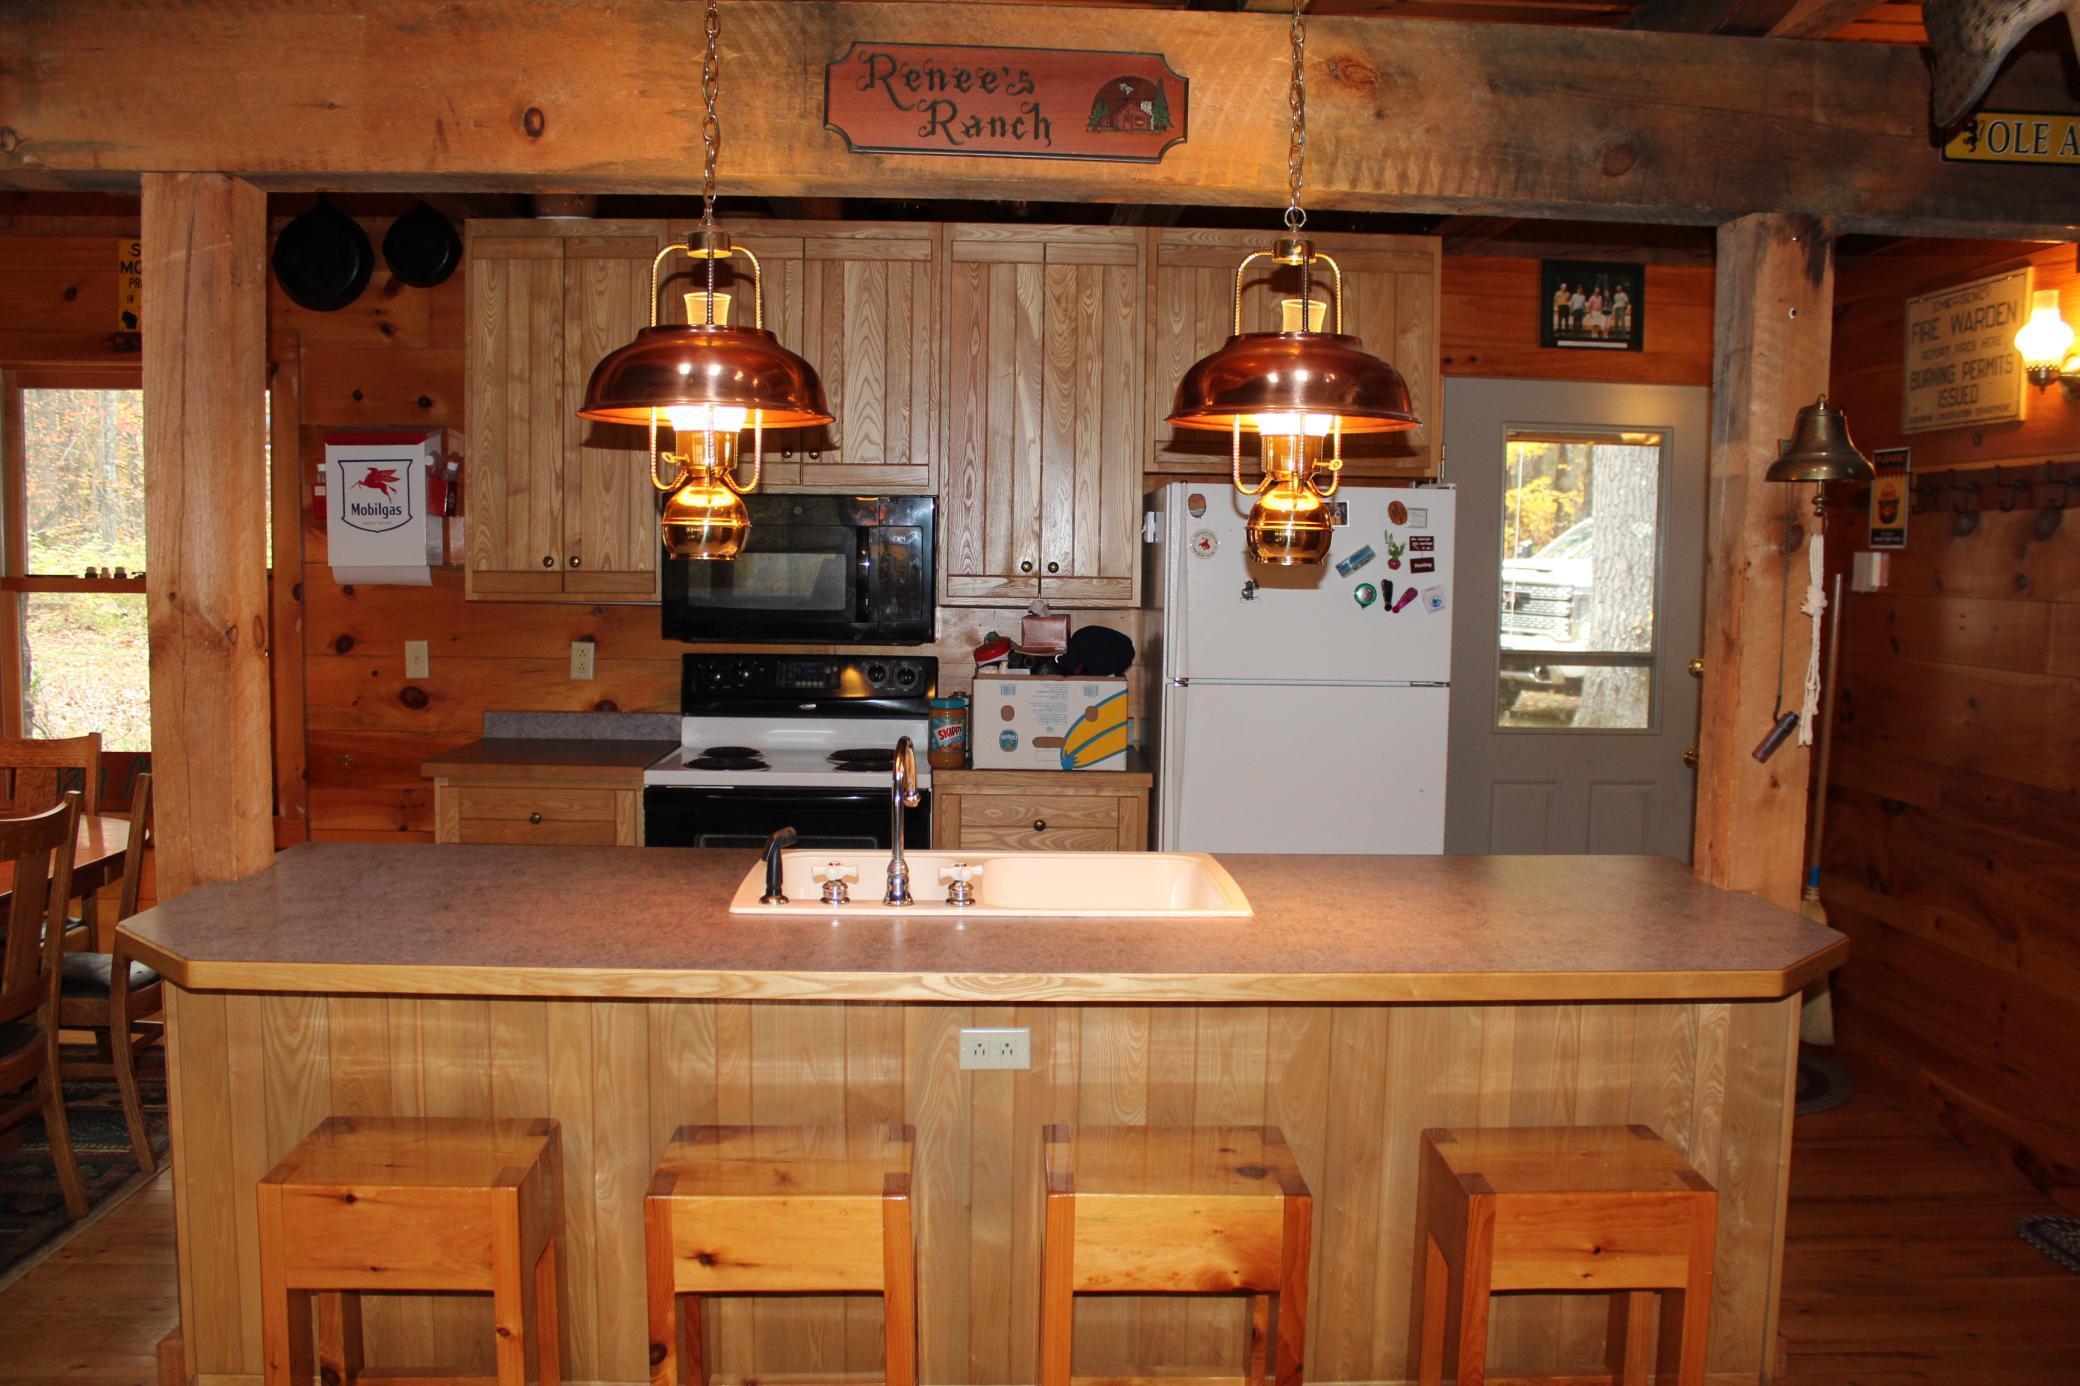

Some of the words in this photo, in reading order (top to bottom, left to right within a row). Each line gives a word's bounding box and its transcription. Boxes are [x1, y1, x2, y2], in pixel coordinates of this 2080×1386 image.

[856, 51, 1036, 111] Renee's
[918, 98, 1052, 147] Ranch
[1987, 120, 2049, 156] OLE
[1912, 317, 1941, 346] FIRE
[1950, 301, 2017, 336] WARDEN
[1910, 364, 1956, 391] BURNING
[1962, 353, 2013, 382] PERMITS
[1938, 384, 1979, 409] ISSUED
[351, 502, 402, 519] Mobilgas
